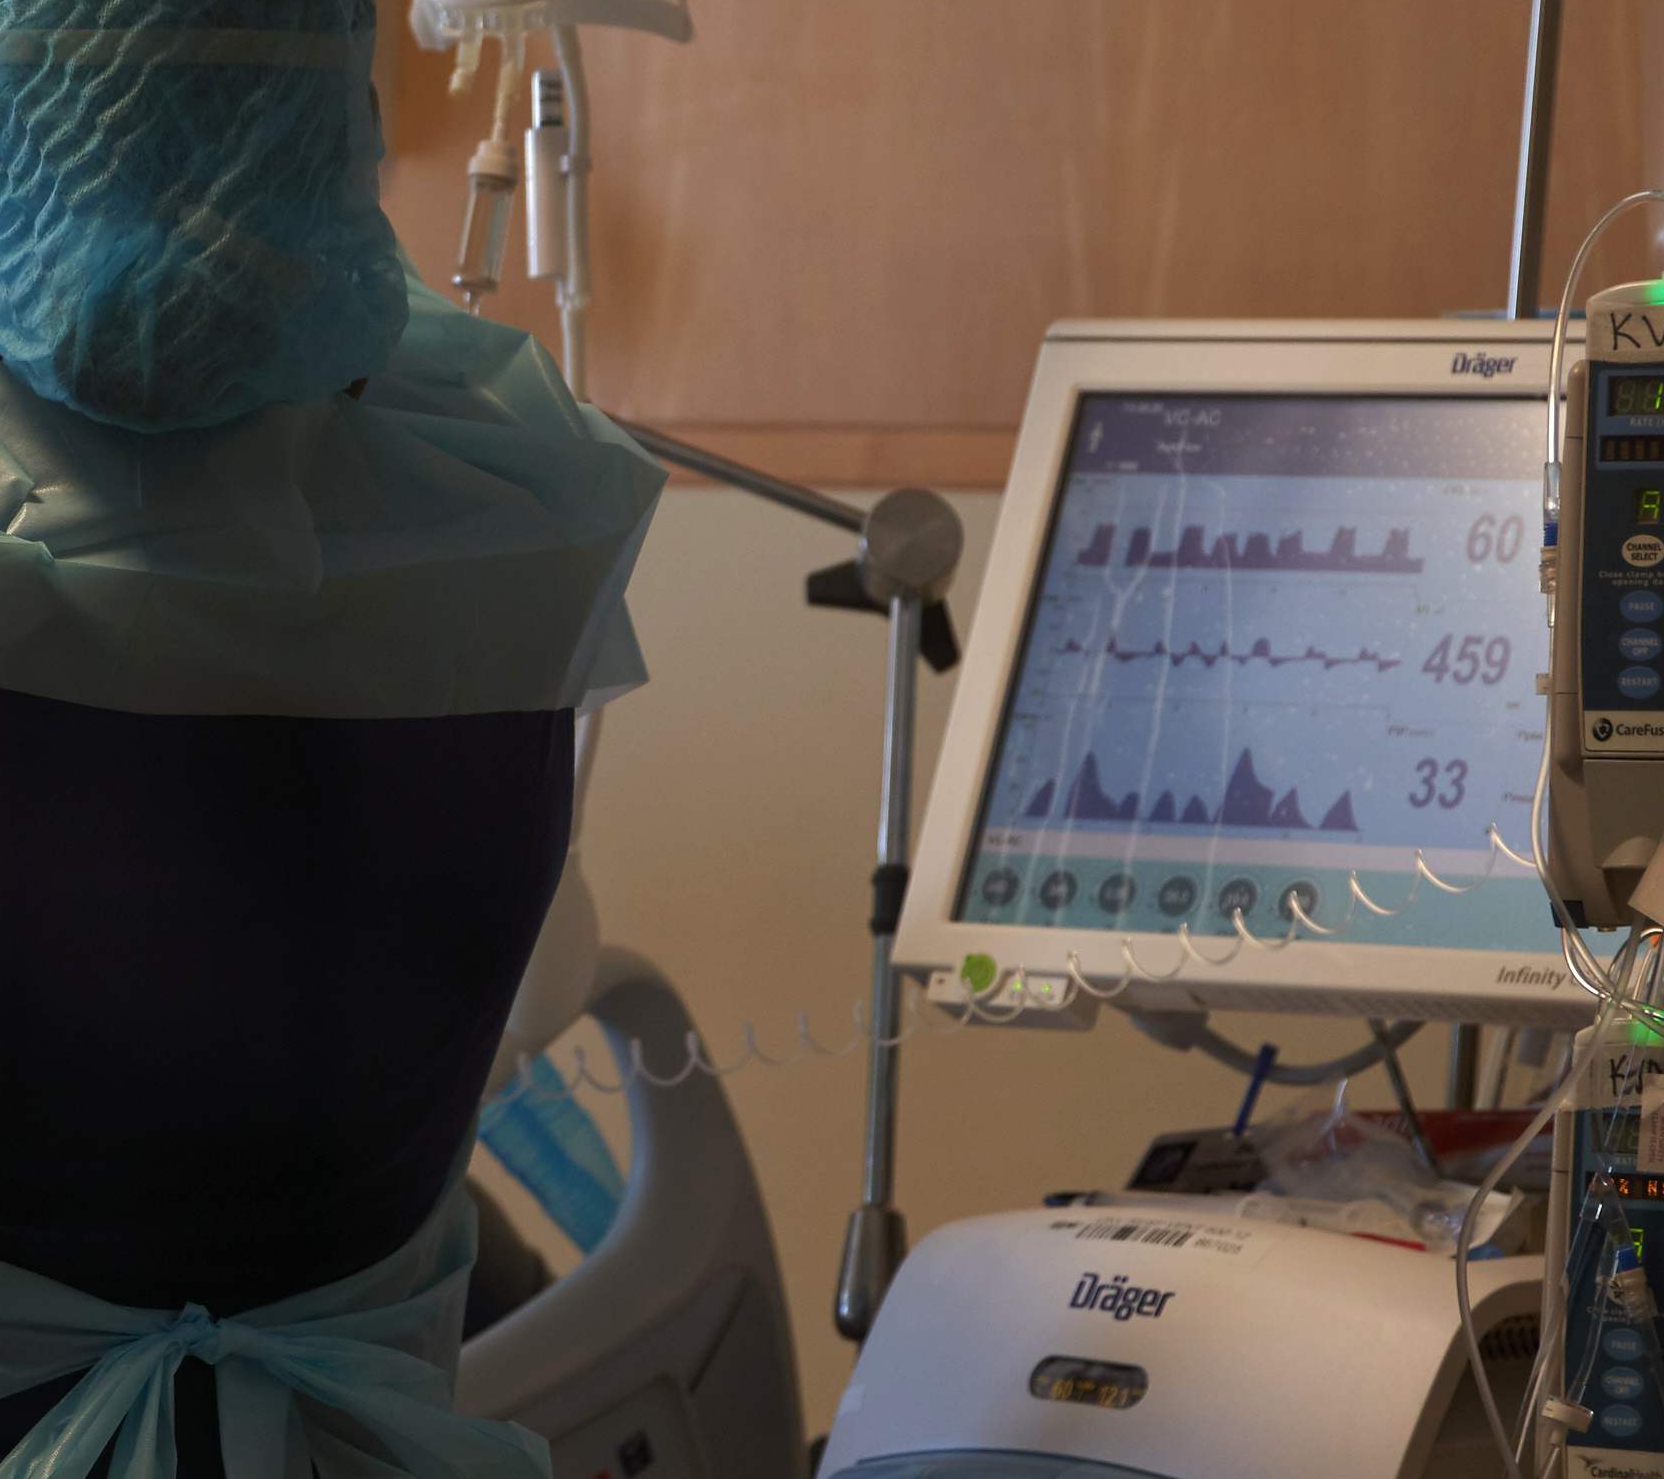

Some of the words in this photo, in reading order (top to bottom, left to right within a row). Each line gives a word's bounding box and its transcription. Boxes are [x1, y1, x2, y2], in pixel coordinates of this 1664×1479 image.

[1450, 351, 1518, 379] Dräger
[1629, 416, 1654, 427] RATE
[1465, 514, 1525, 564] 60
[1627, 541, 1662, 552] CHANNEL
[1631, 552, 1658, 562] SELECT
[1629, 601, 1655, 611] PAUSE
[1622, 637, 1659, 647] CHANNEL
[1421, 633, 1512, 686] 459
[1407, 756, 1469, 810] 33
[1496, 965, 1566, 990] Infinity
[1068, 1270, 1177, 1322] Dräger
